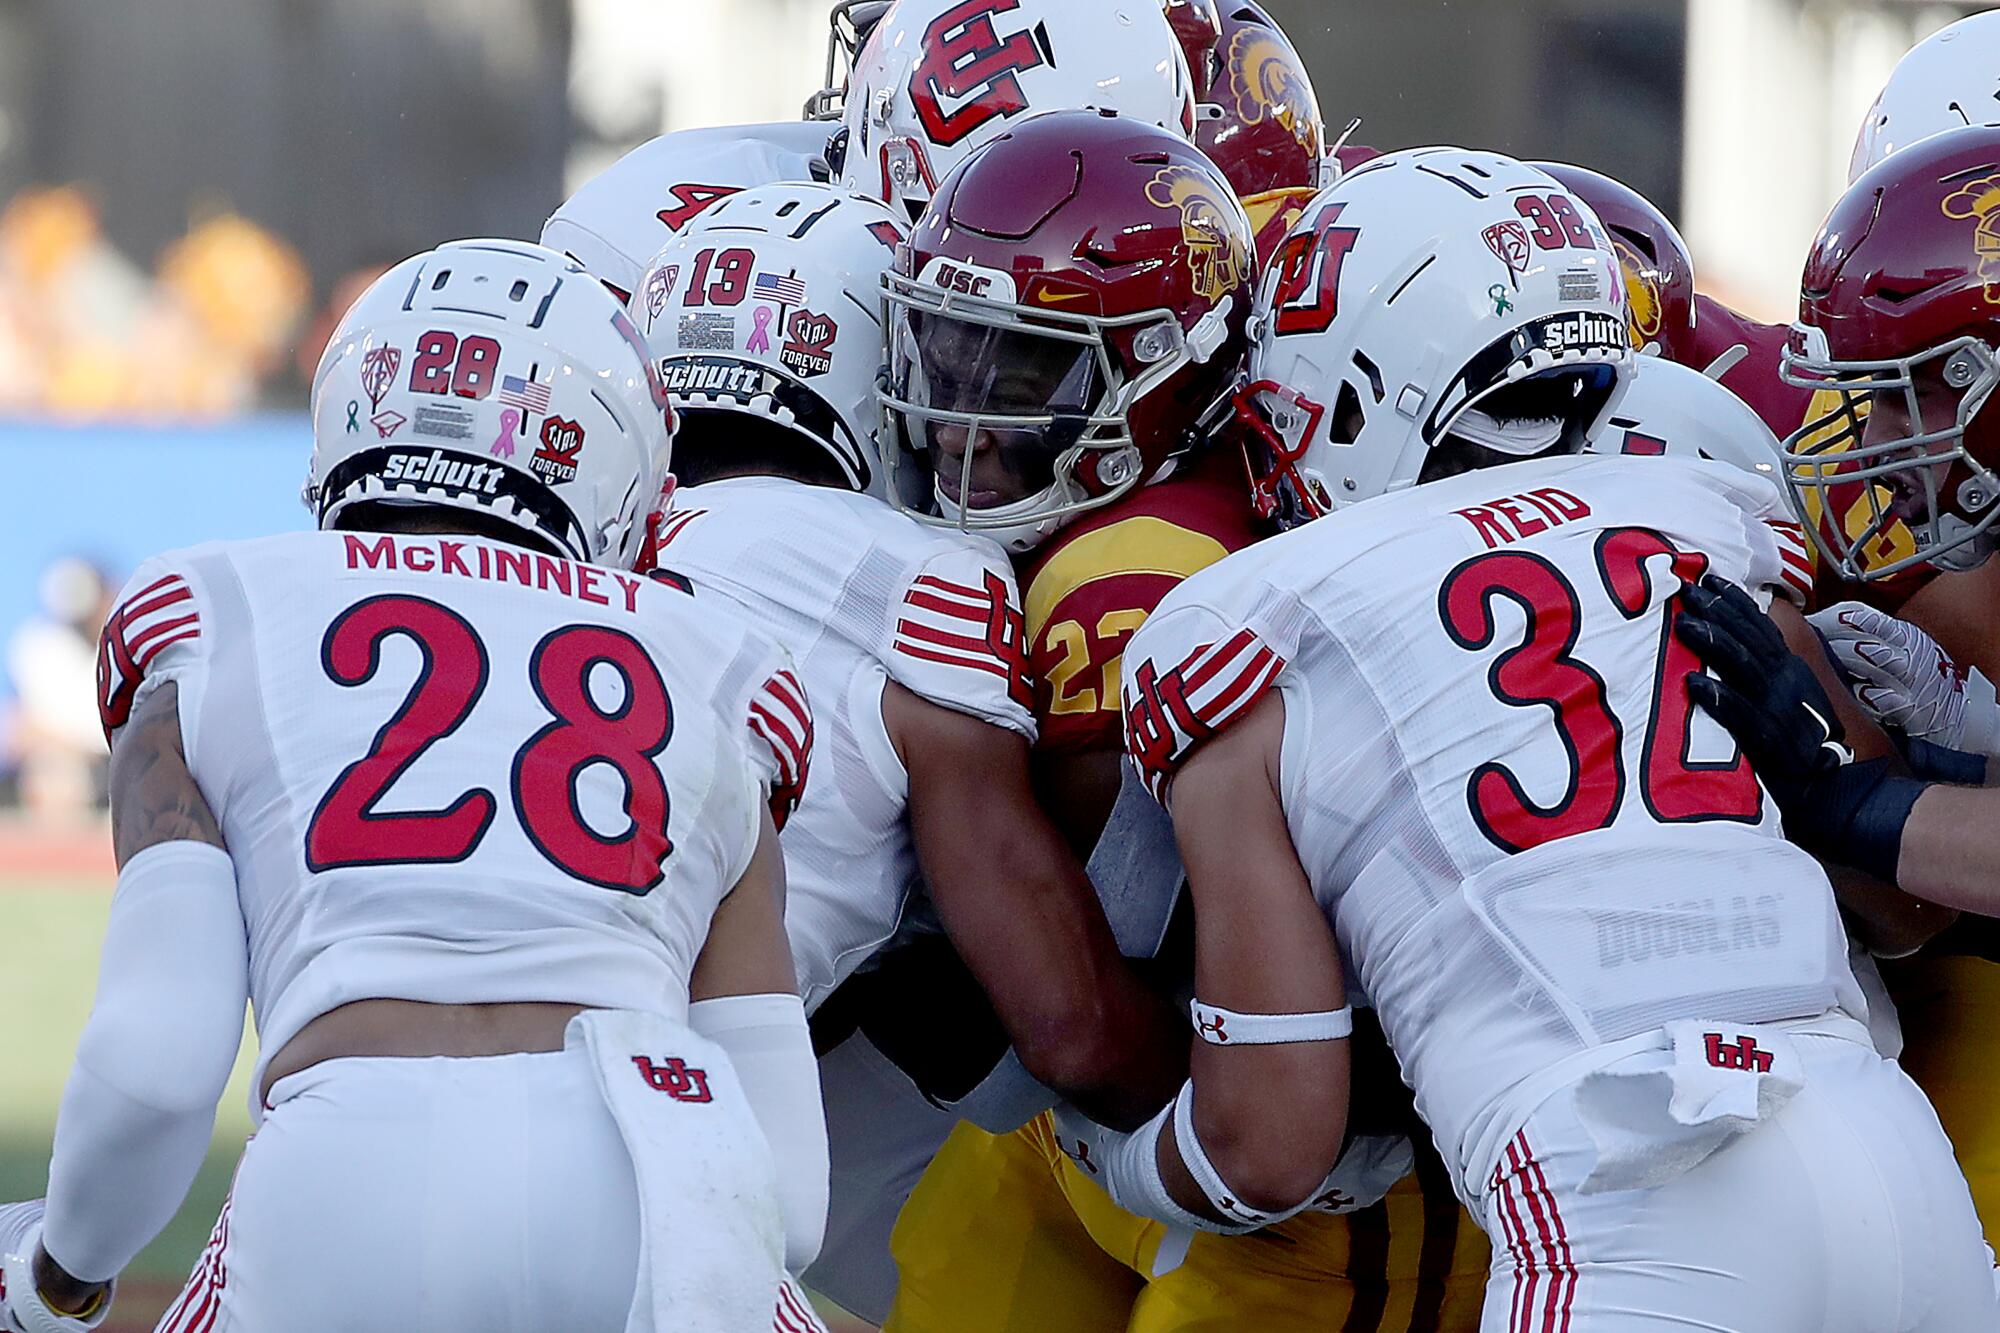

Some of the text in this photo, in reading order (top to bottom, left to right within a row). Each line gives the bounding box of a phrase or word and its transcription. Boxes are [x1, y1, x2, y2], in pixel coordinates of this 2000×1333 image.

[1513, 193, 1597, 251] 32
[682, 248, 756, 307] 13
[935, 262, 992, 299] USC
[1543, 312, 1625, 348] schutt
[408, 330, 502, 401] 28
[781, 349, 830, 373] FOREVER
[382, 449, 506, 495] schutt
[530, 456, 576, 480] FOREVER
[1449, 487, 1592, 549] REID
[343, 534, 643, 614] McKINNEY
[1045, 607, 1150, 715] 22
[1438, 527, 1764, 856] 32
[305, 592, 675, 897] 28
